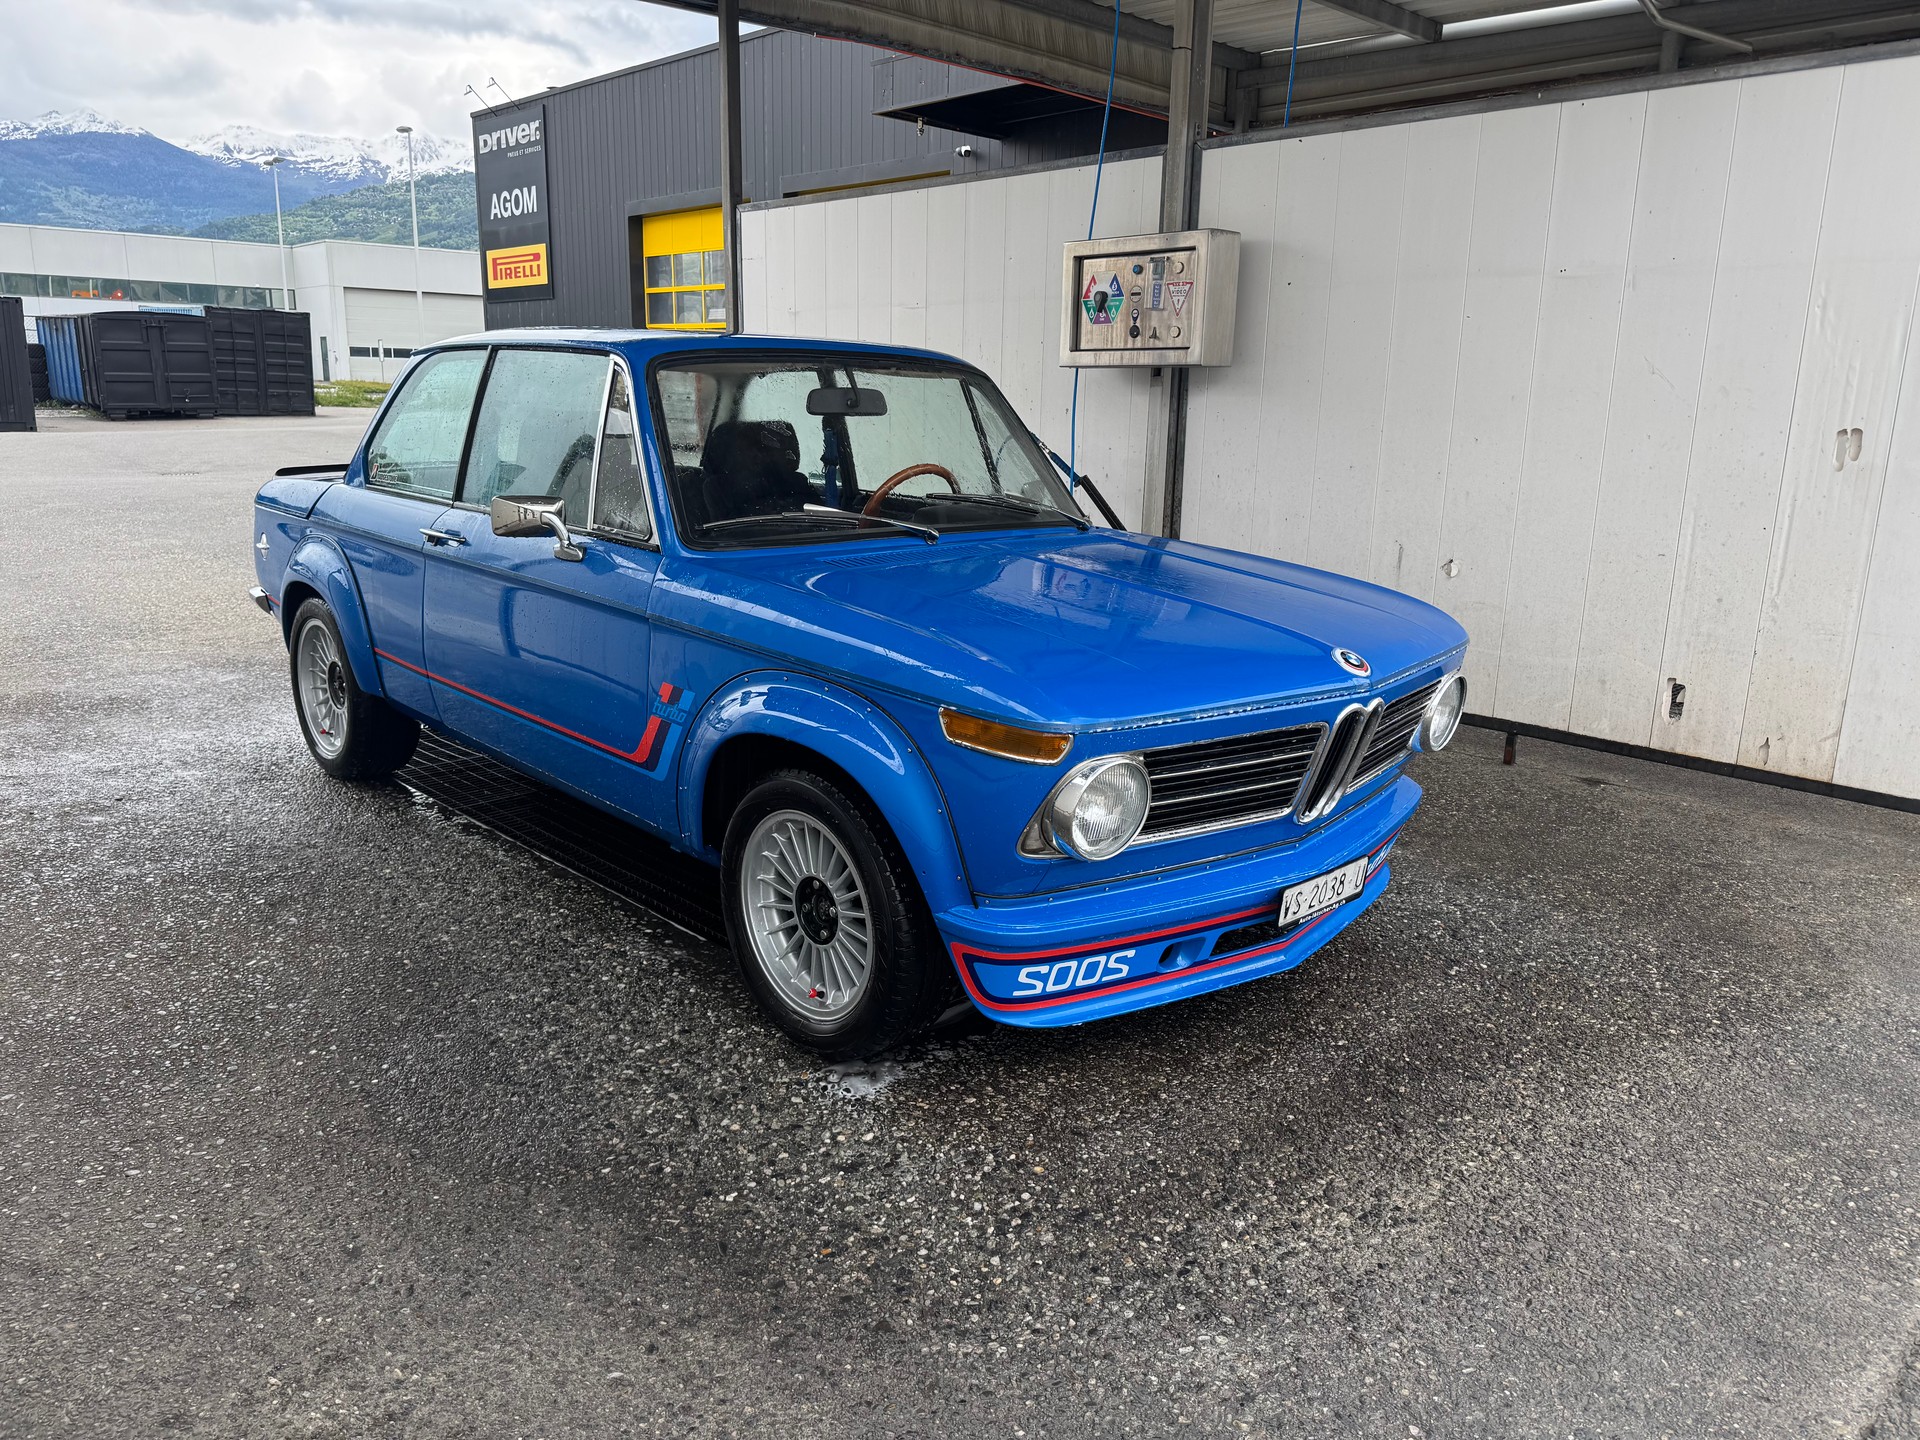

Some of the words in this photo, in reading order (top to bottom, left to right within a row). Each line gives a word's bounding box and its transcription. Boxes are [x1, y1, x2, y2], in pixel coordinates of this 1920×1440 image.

[490, 185, 538, 220] AGOM
[492, 252, 541, 281] PIRELLI
[652, 697, 687, 723] turbo
